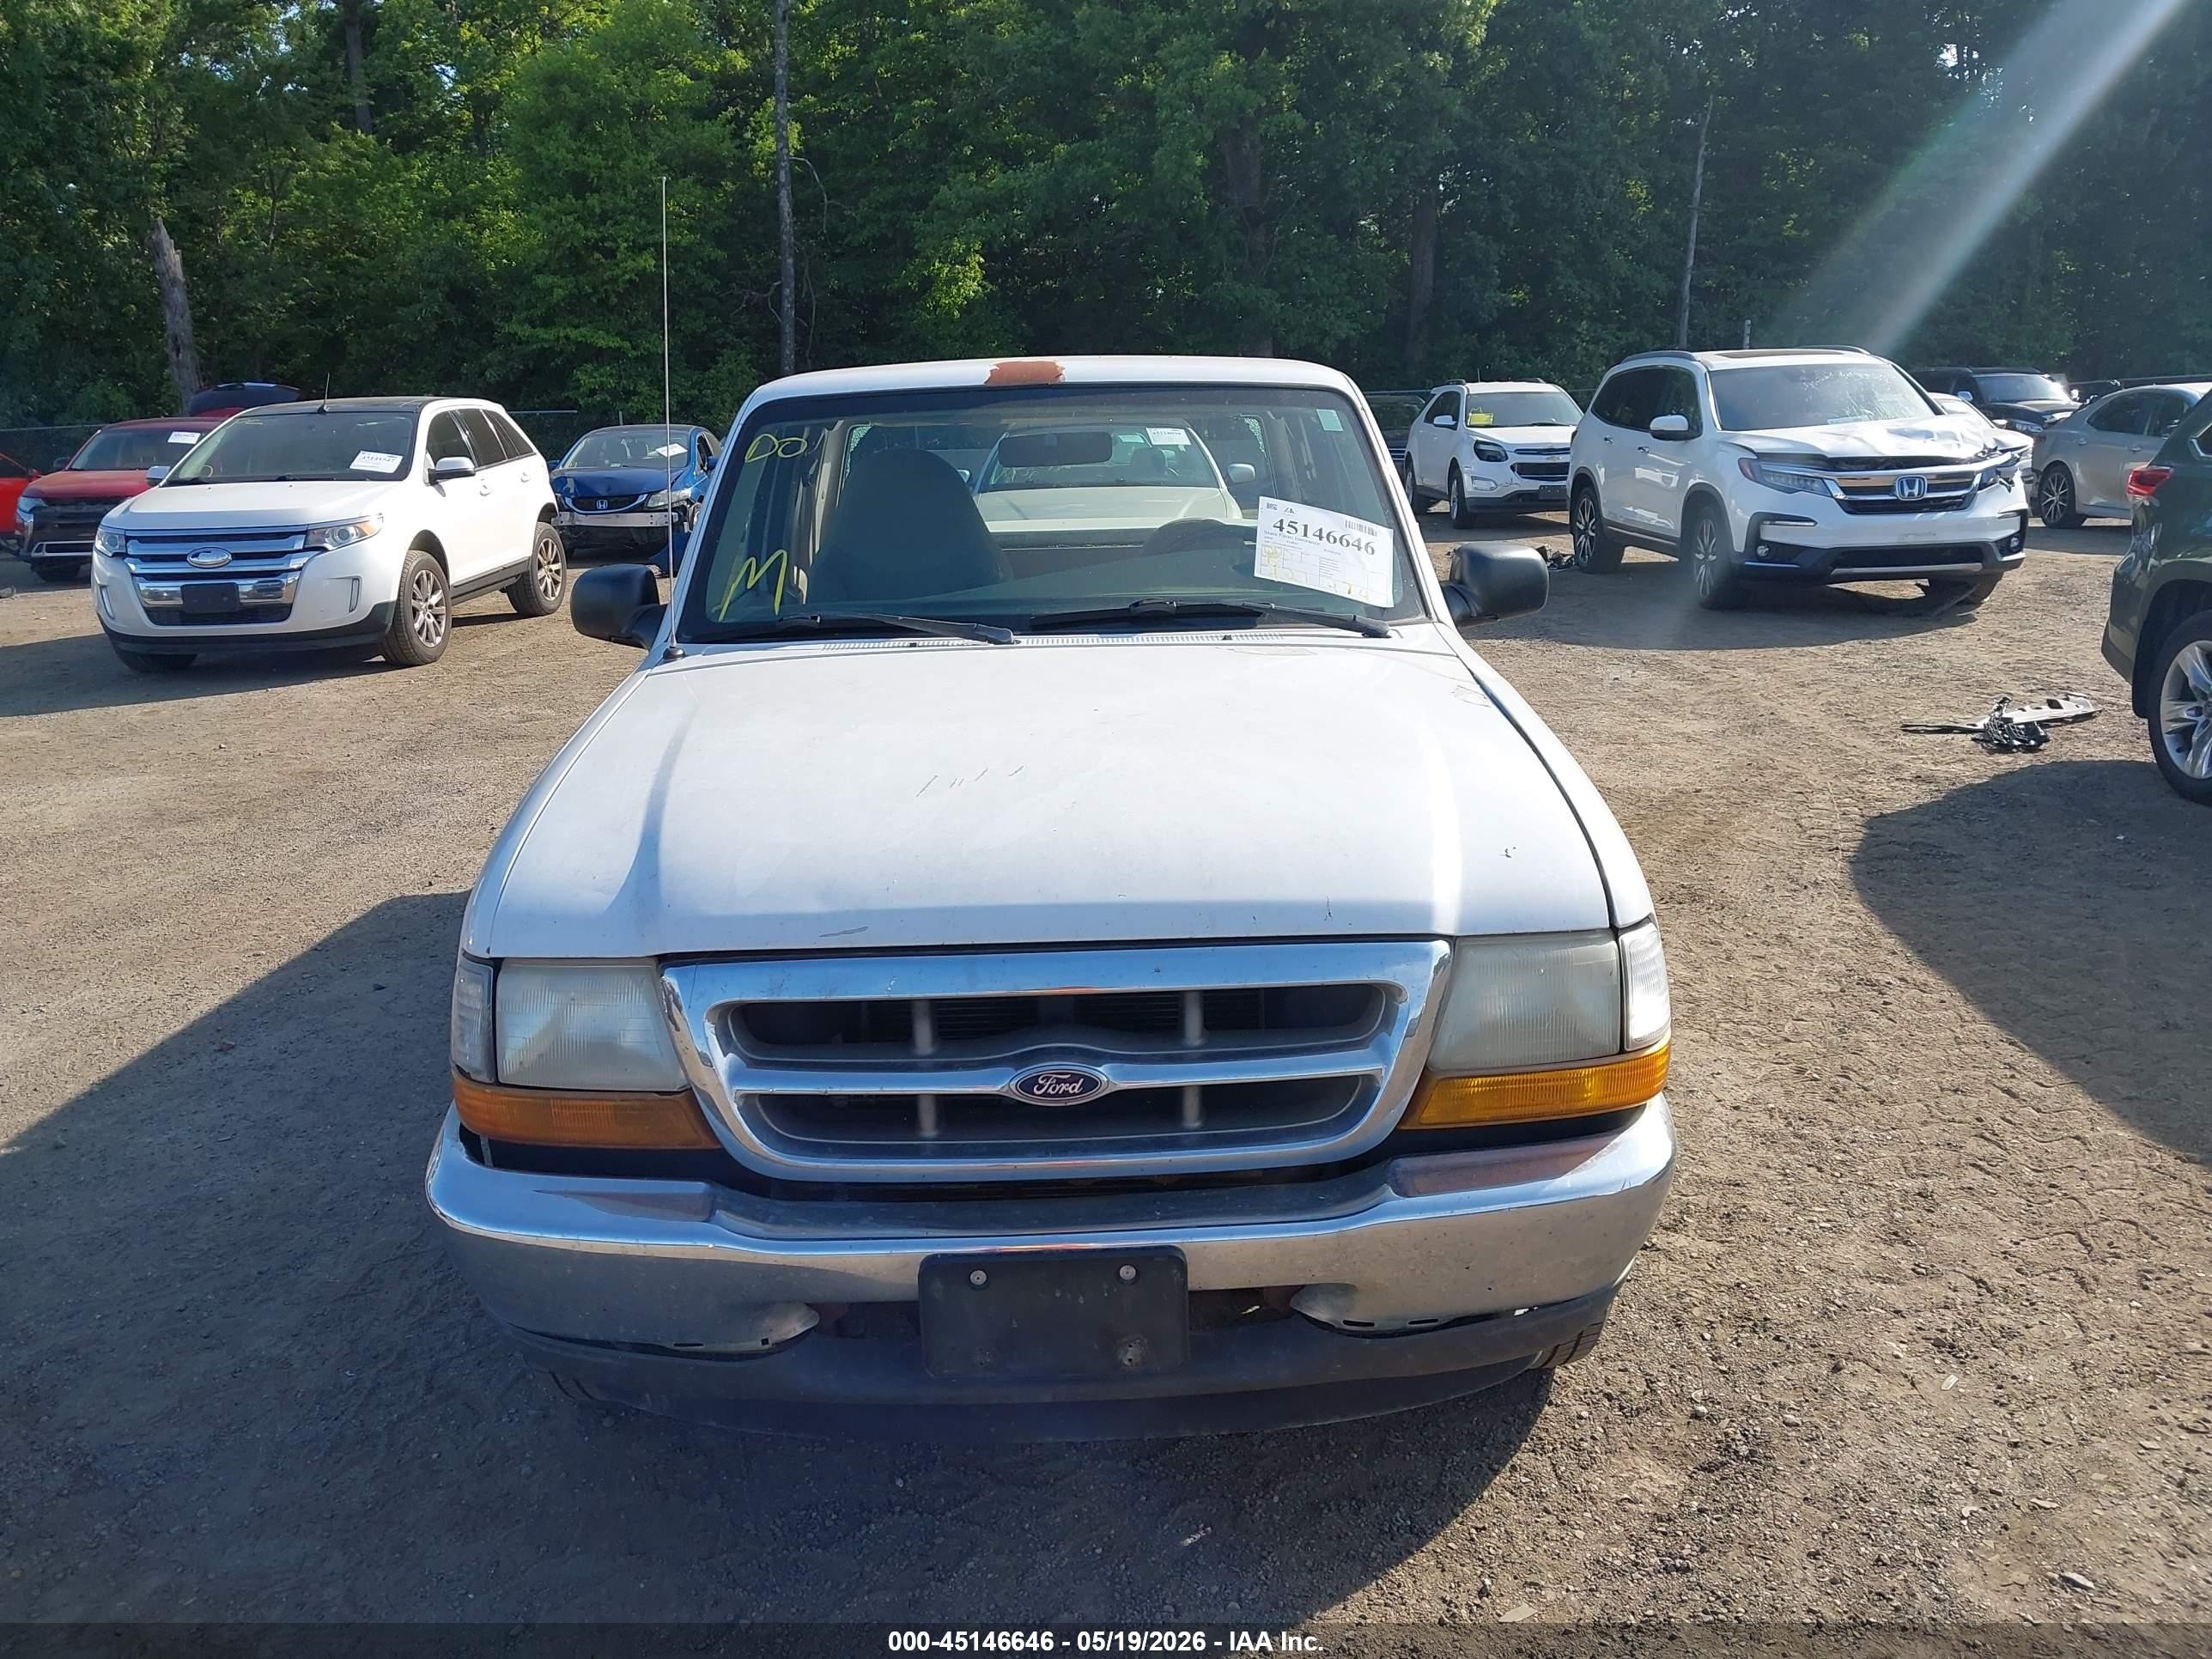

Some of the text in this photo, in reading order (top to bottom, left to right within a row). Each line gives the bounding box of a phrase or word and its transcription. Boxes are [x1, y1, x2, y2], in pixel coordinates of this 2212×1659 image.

[1273, 518, 1376, 556] 45146646
[718, 549, 788, 623] M
[1033, 1073, 1085, 1095] Ford
